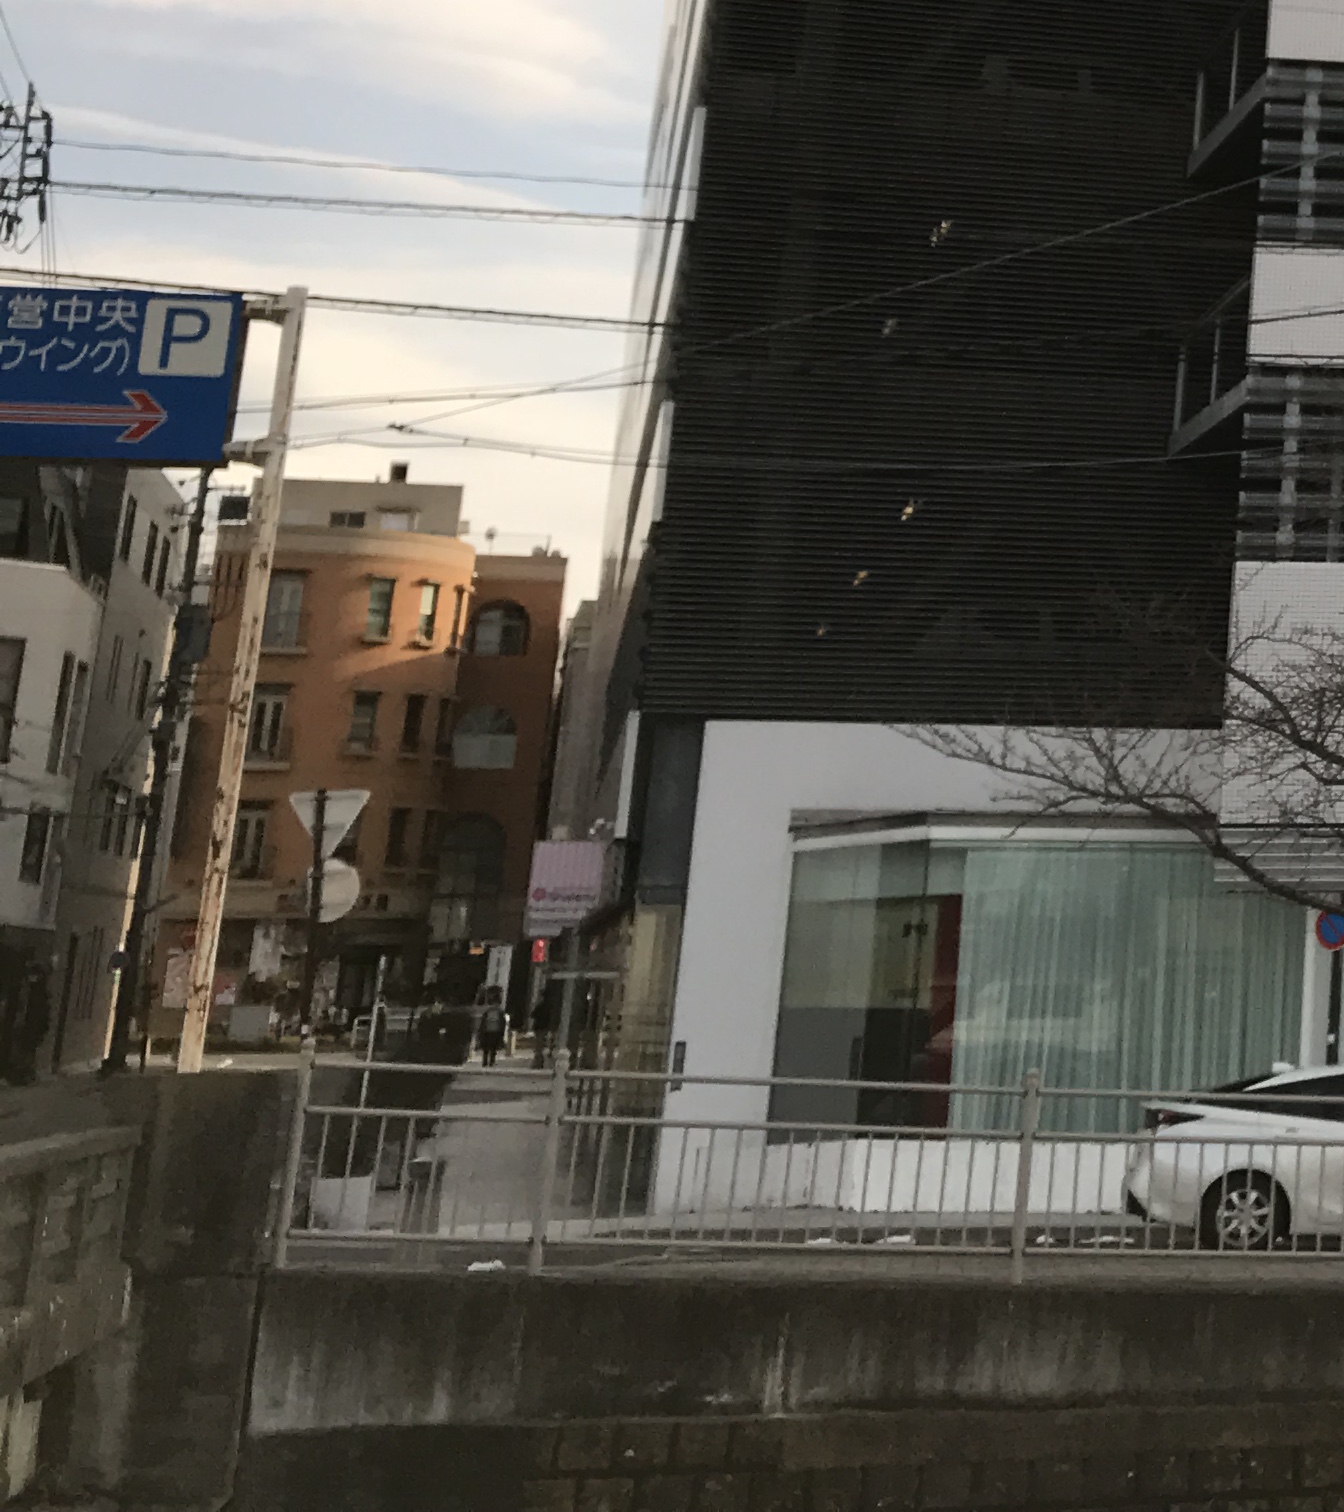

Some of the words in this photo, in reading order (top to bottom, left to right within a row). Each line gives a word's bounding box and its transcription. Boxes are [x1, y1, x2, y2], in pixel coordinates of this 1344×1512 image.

[0, 294, 138, 334] 営中央
[158, 307, 211, 371] P
